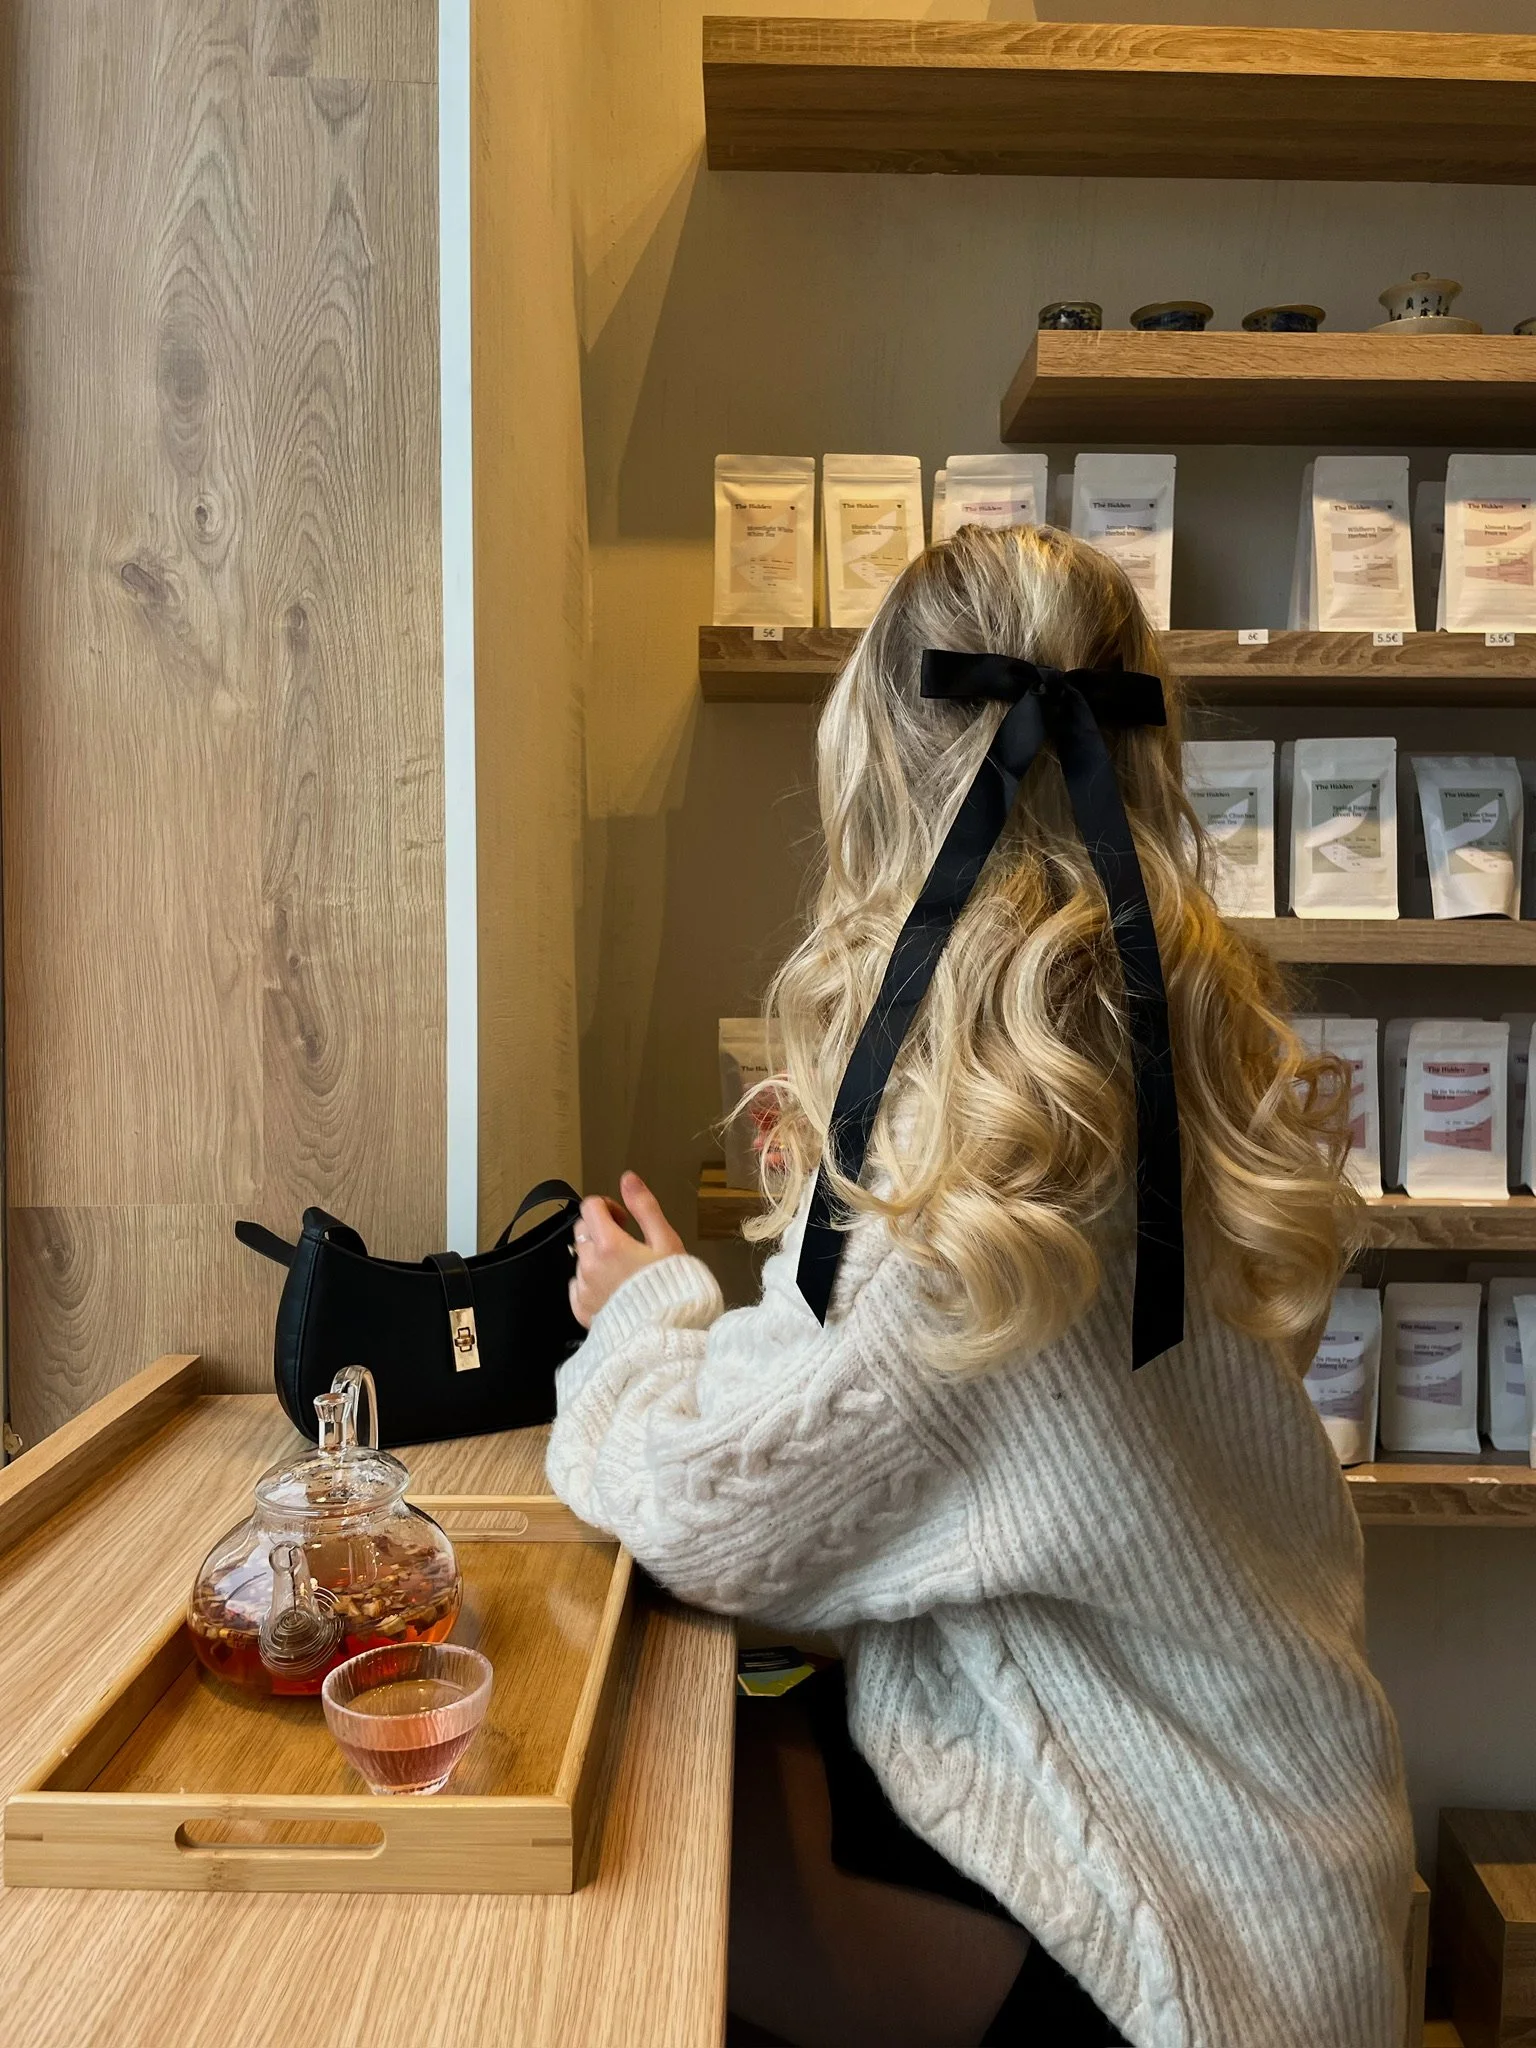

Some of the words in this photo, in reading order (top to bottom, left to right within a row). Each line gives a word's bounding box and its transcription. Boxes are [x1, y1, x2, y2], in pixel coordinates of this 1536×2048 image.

[763, 628, 776, 638] 5€
[1377, 632, 1399, 643] 5.5€
[1489, 633, 1511, 644] 5.5€
